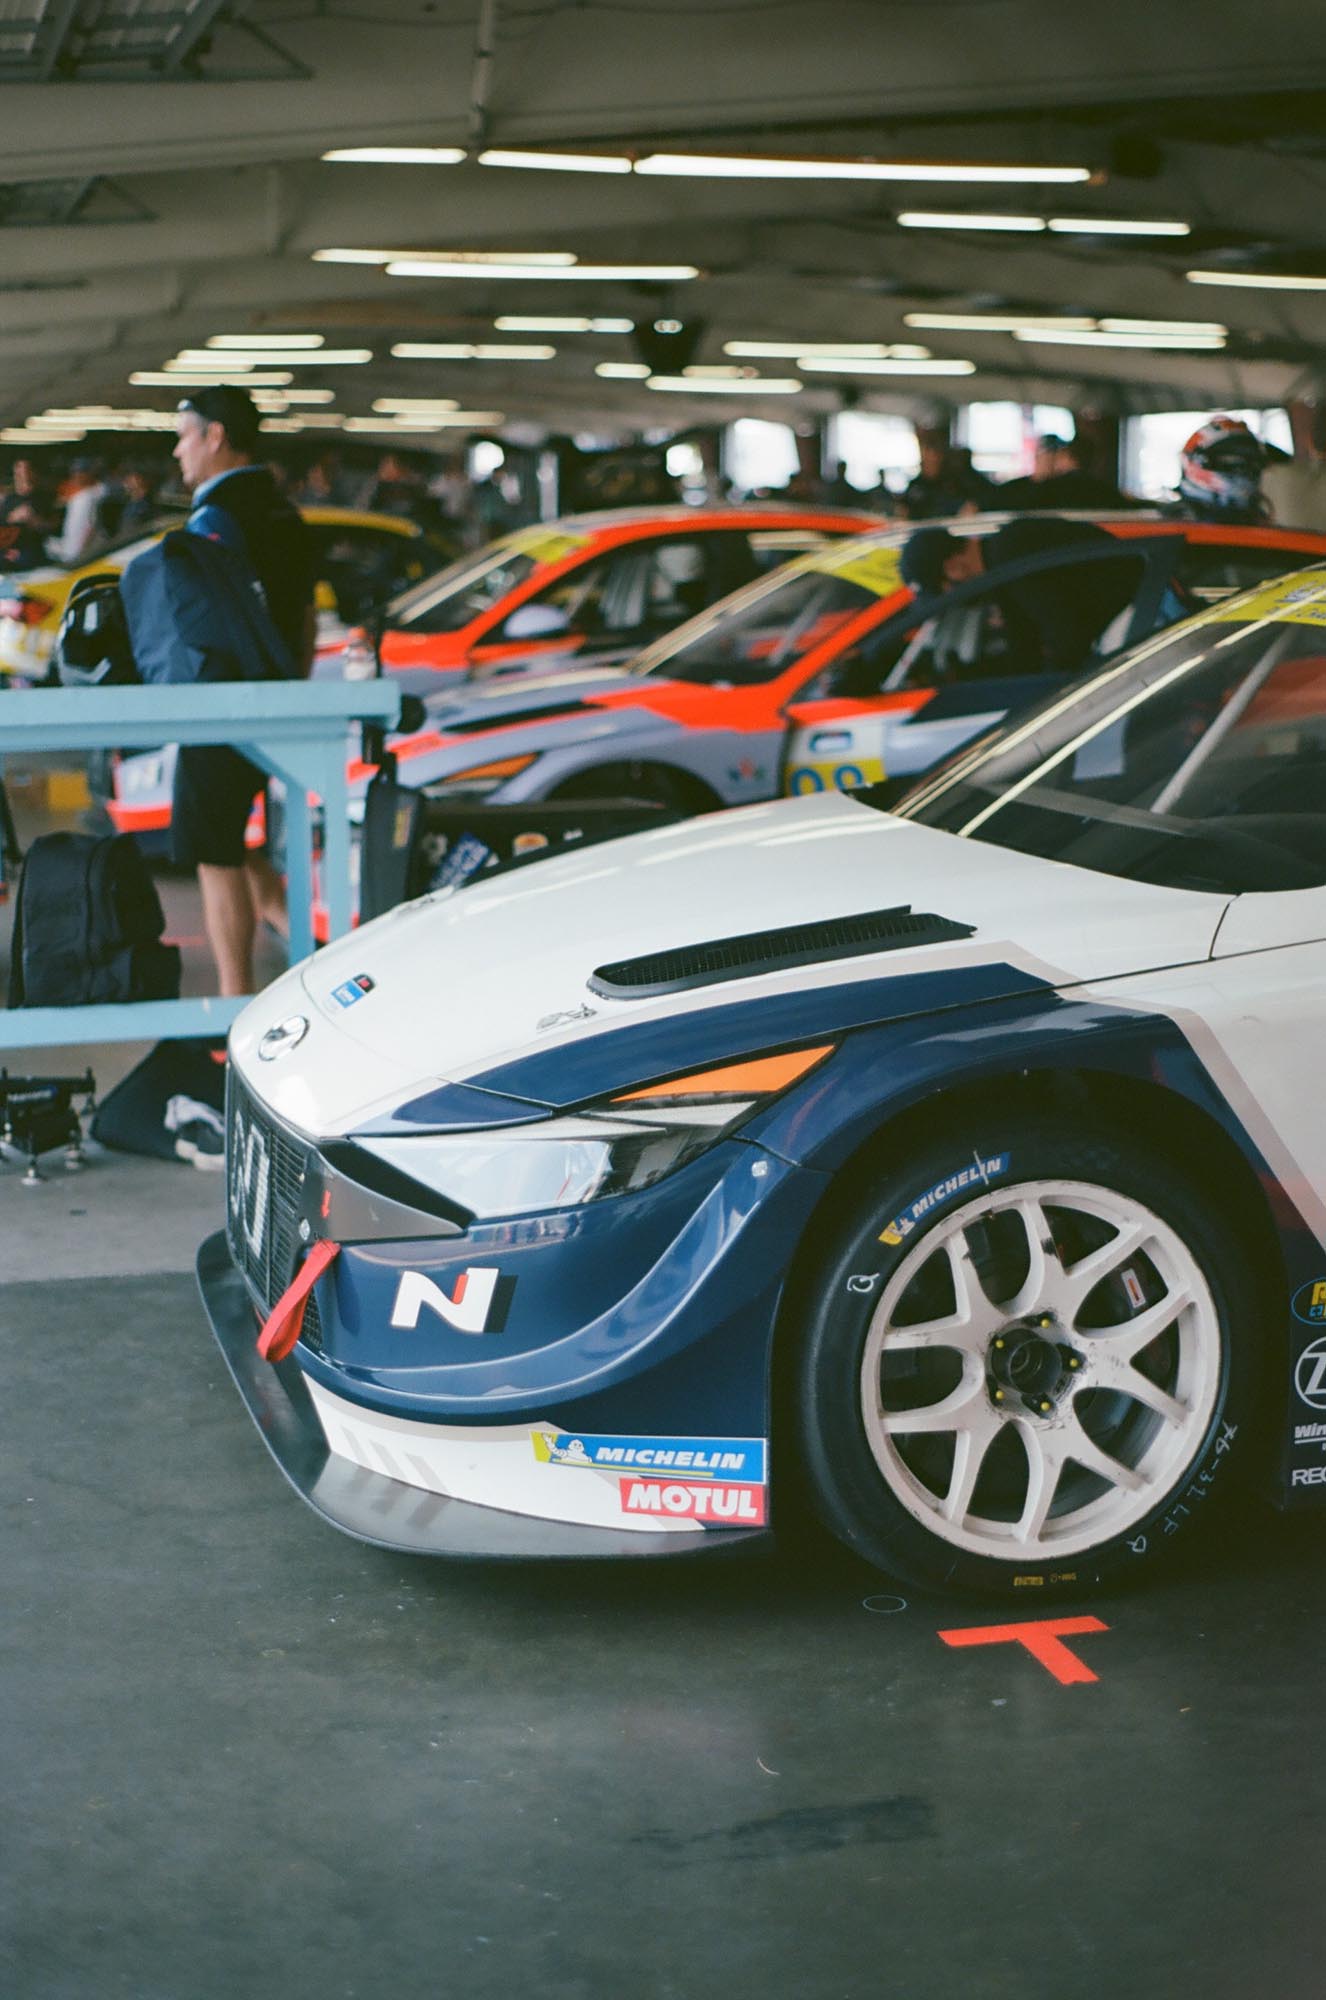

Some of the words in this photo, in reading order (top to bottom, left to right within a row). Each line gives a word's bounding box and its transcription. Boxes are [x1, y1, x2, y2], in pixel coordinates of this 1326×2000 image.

[911, 1157, 1001, 1218] MICHELIN
[390, 1267, 500, 1334] N
[595, 1447, 746, 1470] MICHELIN
[627, 1483, 758, 1518] MOTUL
